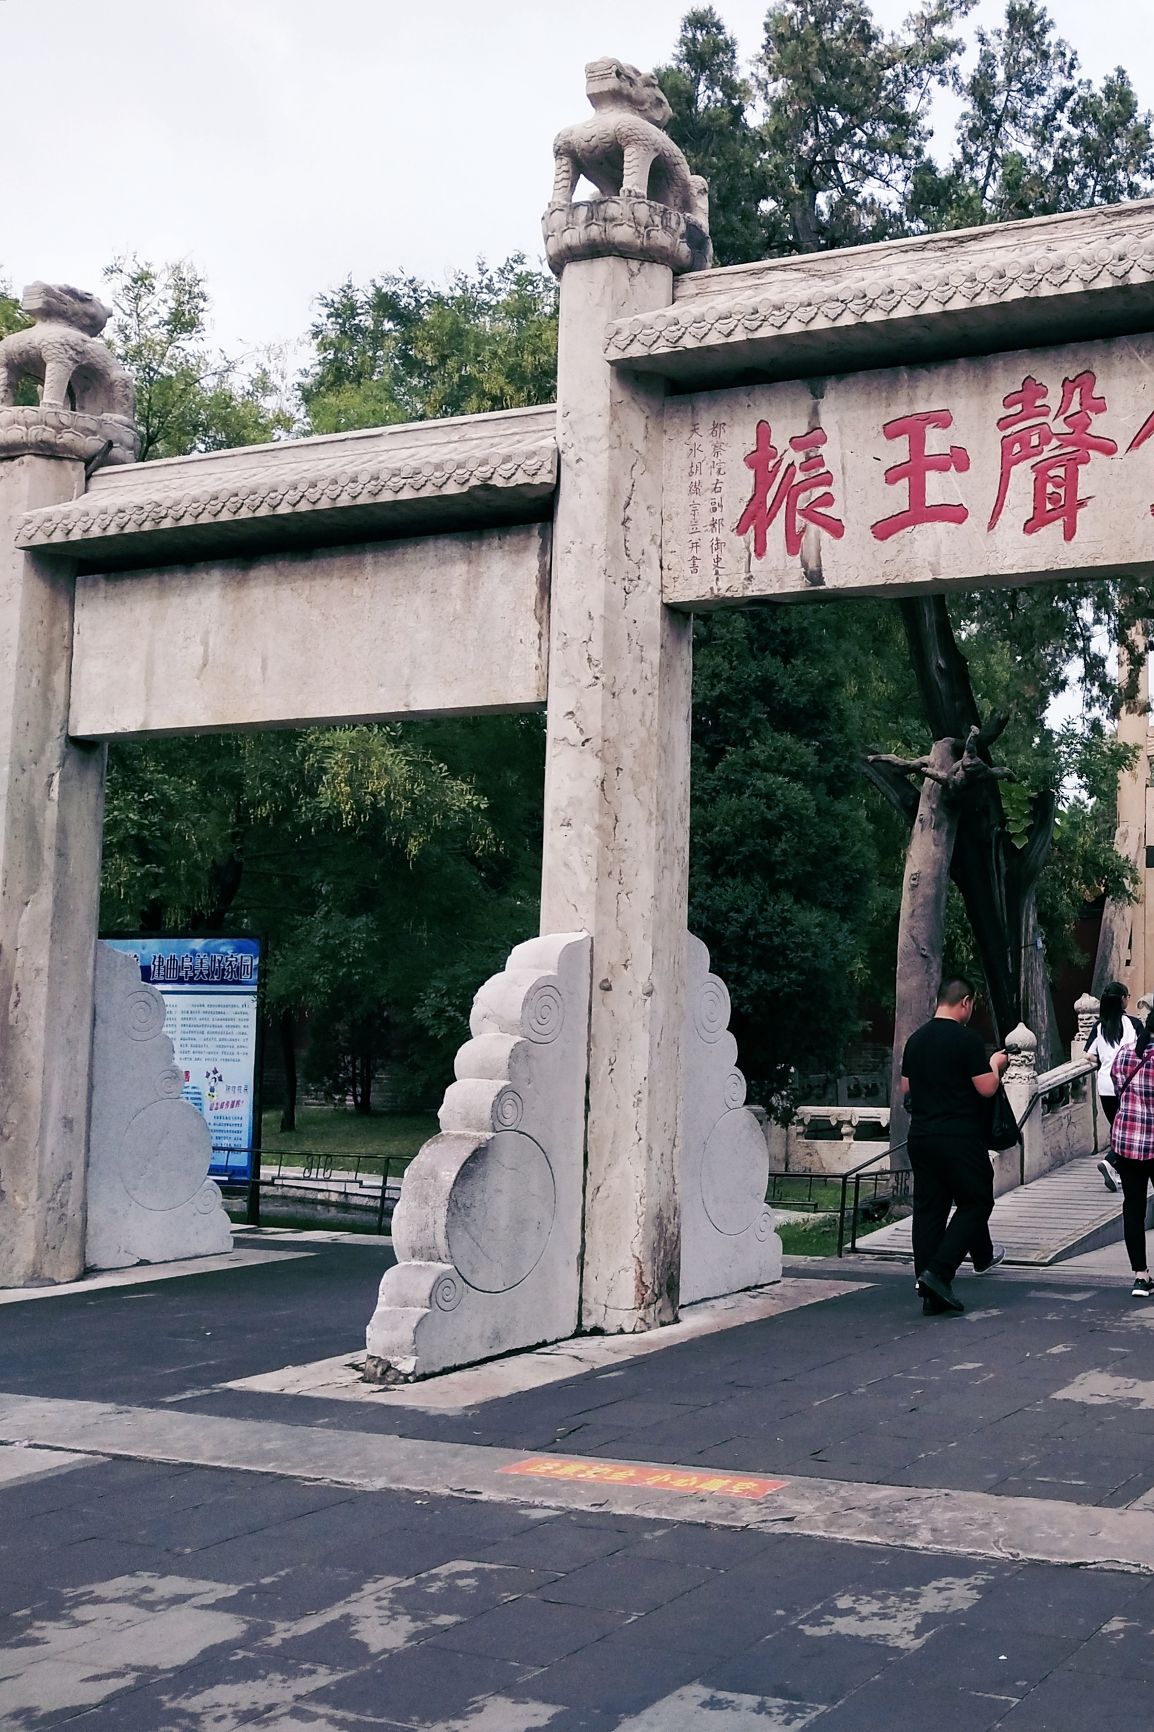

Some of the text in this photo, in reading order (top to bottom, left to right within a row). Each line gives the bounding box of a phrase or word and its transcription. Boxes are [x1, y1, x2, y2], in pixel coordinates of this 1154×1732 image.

[150, 953, 254, 981] 建曲阜美好家园
